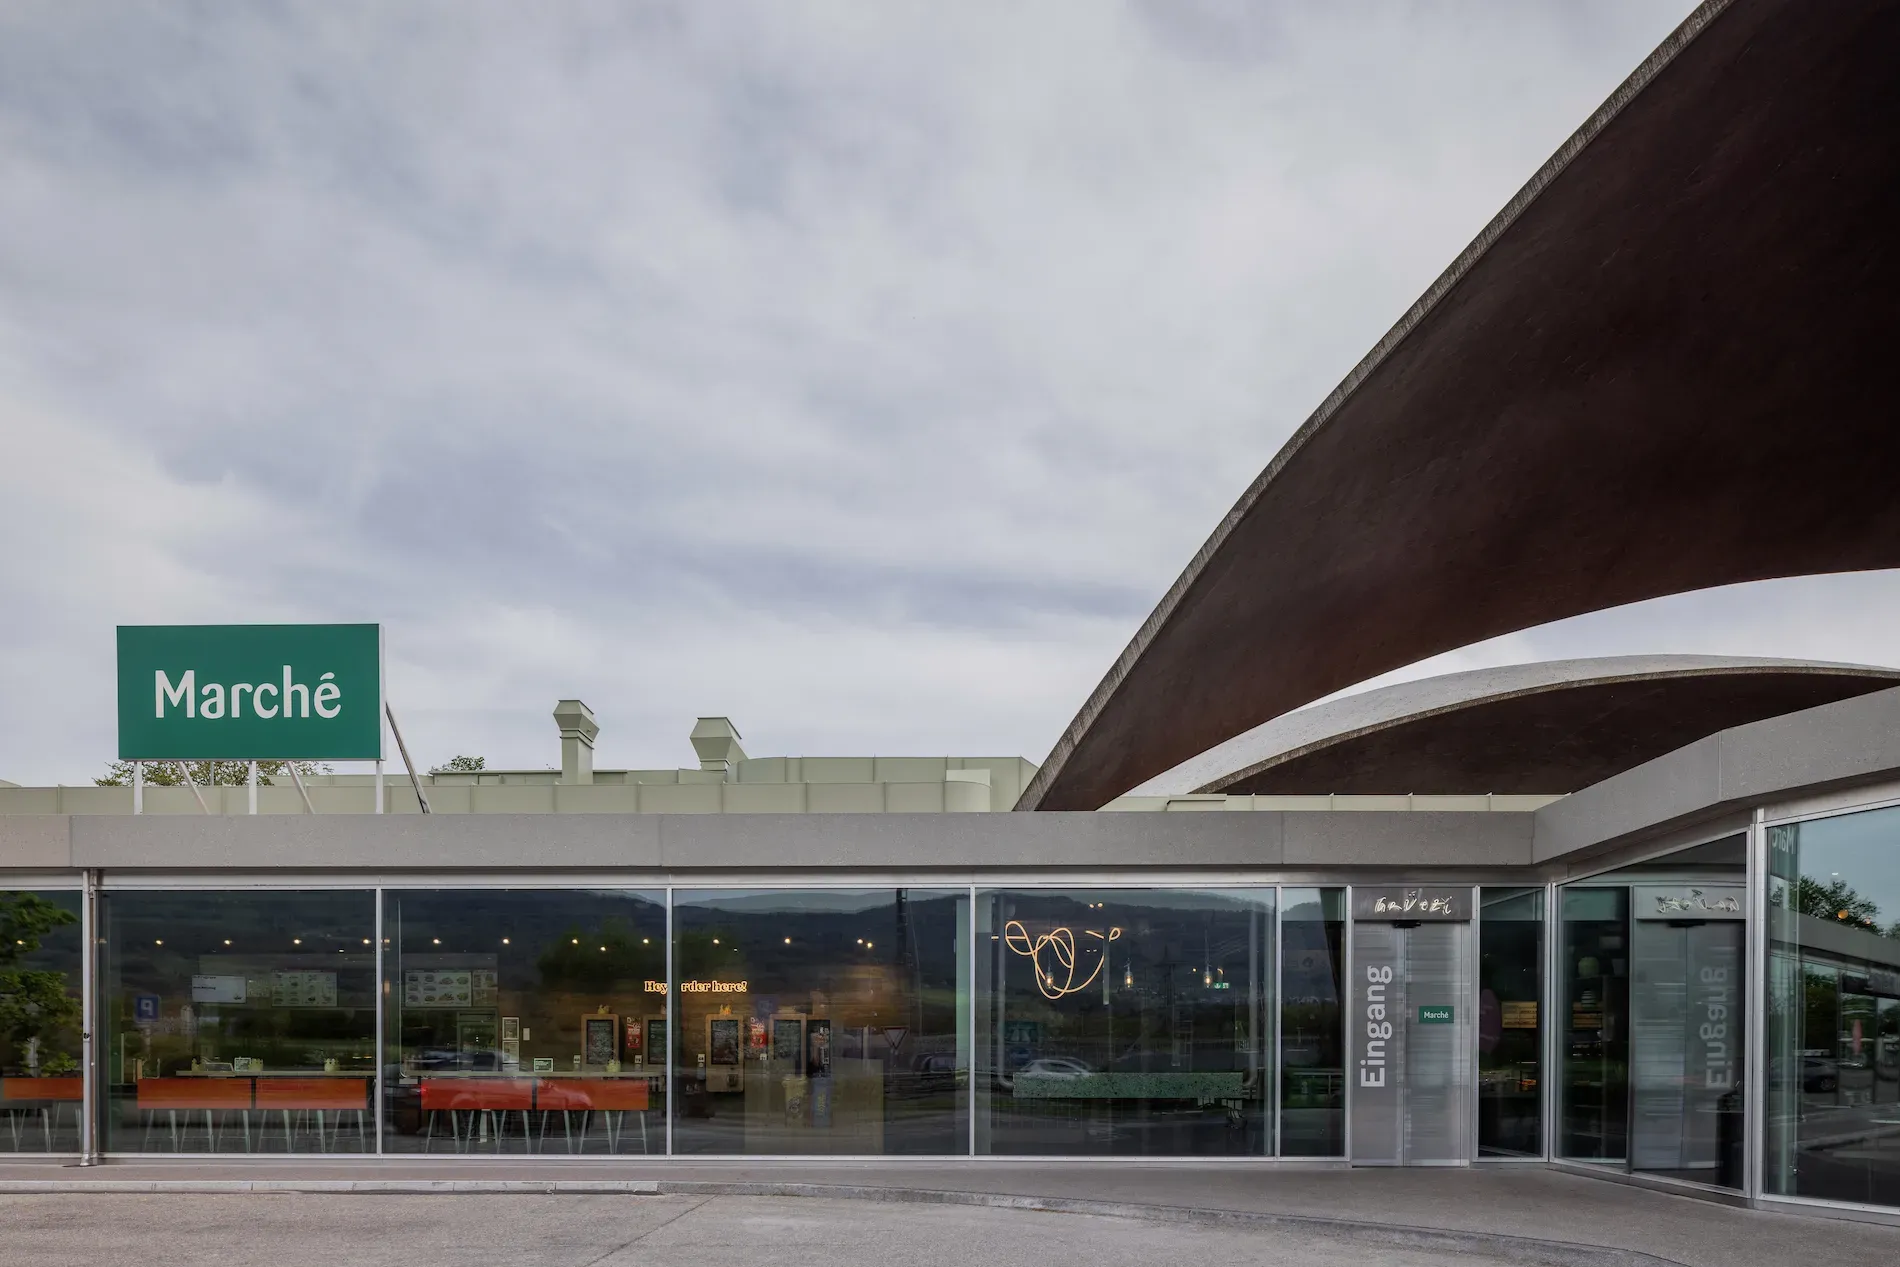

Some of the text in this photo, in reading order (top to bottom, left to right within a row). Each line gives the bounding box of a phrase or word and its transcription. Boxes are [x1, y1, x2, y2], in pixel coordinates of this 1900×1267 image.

[155, 665, 341, 719] Marché
[644, 980, 748, 995] Hey rder here!
[1360, 965, 1393, 1088] Eingang
[1423, 1011, 1449, 1019] Marché
